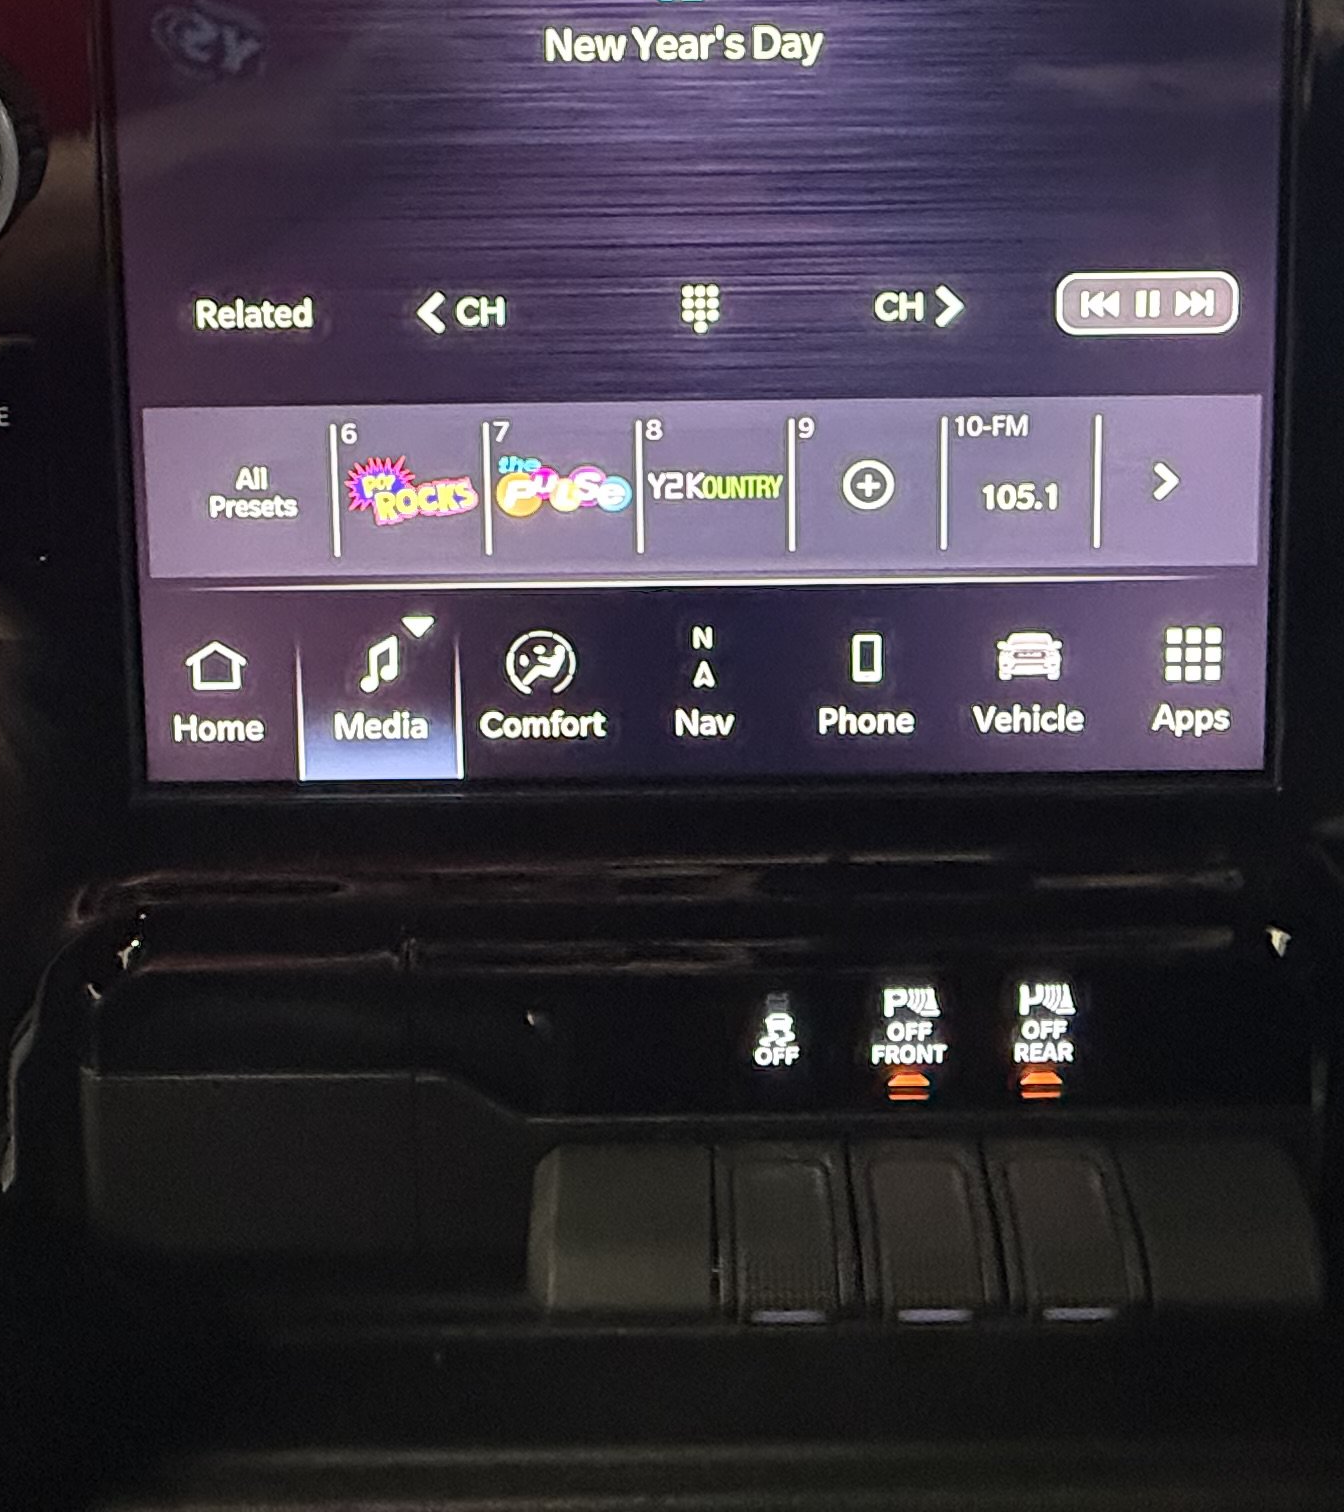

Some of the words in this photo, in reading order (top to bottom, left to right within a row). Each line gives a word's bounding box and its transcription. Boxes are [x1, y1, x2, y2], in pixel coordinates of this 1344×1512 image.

[544, 26, 628, 62] New
[631, 24, 746, 61] Year's
[751, 24, 825, 68] Day
[194, 295, 316, 331] Related
[455, 295, 507, 328] CH
[873, 290, 924, 323] CH
[340, 422, 358, 445] 6
[493, 420, 512, 443] 7
[645, 419, 664, 442] 8
[798, 417, 816, 439] 9
[954, 414, 1030, 438] 10-FM
[235, 466, 269, 492] All
[208, 494, 299, 520] Presets
[374, 481, 476, 521] ROCKS
[982, 482, 1060, 511] 105.1
[173, 713, 266, 743] Home
[333, 709, 429, 741] Media
[479, 707, 608, 740] Comfort
[674, 708, 735, 737] Nav
[817, 704, 916, 736] Phone
[972, 702, 1086, 735] Vehicle
[1152, 703, 1232, 738] Apps
[886, 1021, 934, 1042] OFF
[1021, 1019, 1069, 1041] OFF
[754, 1045, 800, 1066] OFF
[871, 1043, 949, 1065] FRONT
[1013, 1041, 1075, 1063] REAR
